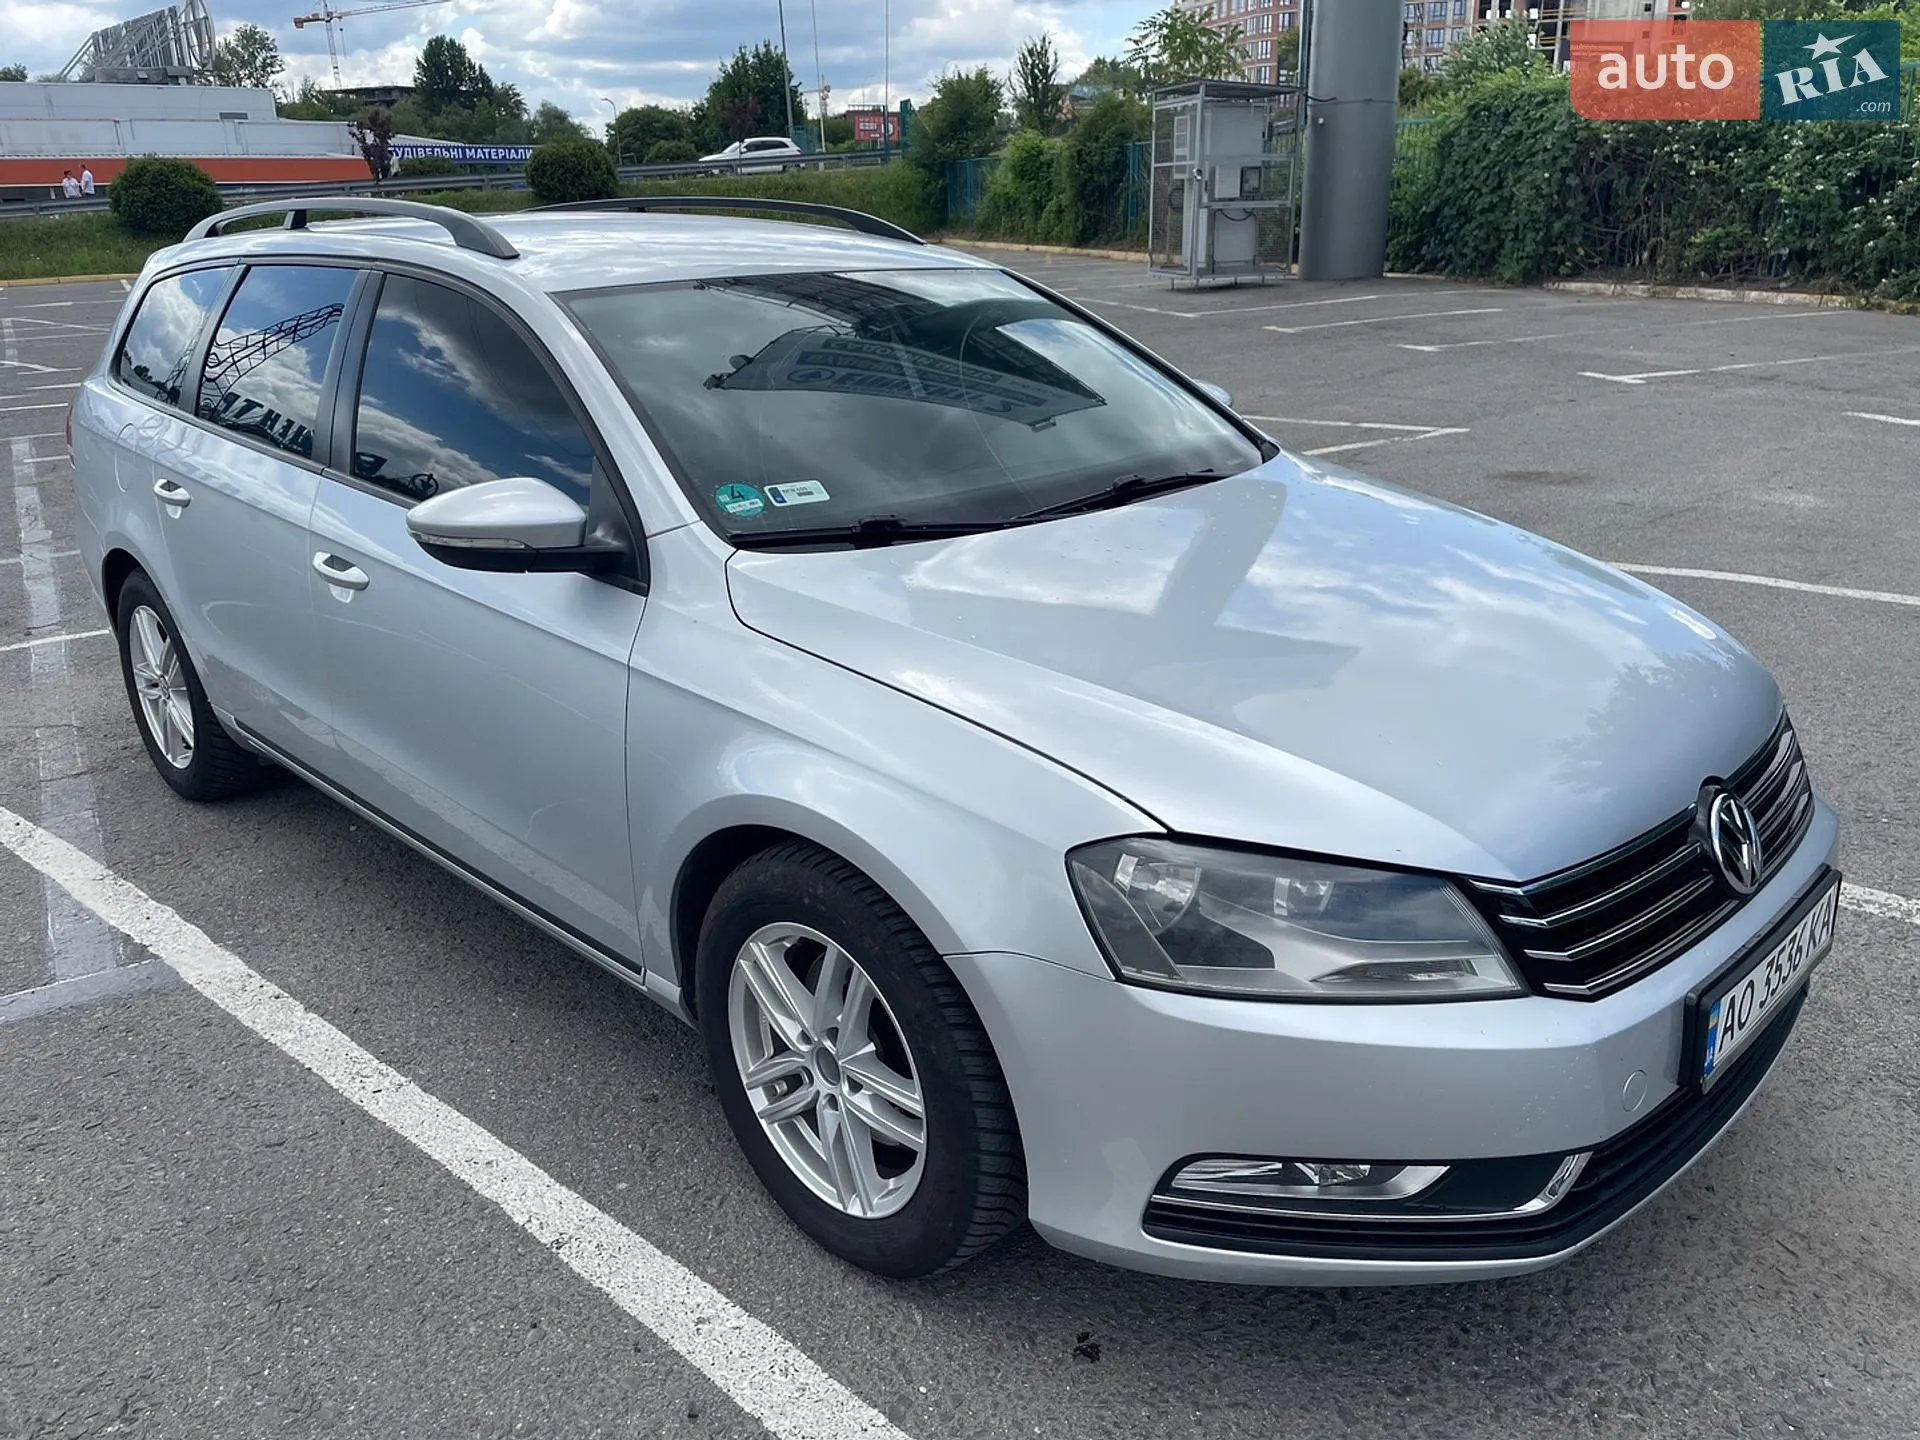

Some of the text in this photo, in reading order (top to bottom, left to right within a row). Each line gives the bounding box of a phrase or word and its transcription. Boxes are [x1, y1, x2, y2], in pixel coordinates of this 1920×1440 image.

[1718, 894, 1832, 1053] AO 3536 KA
